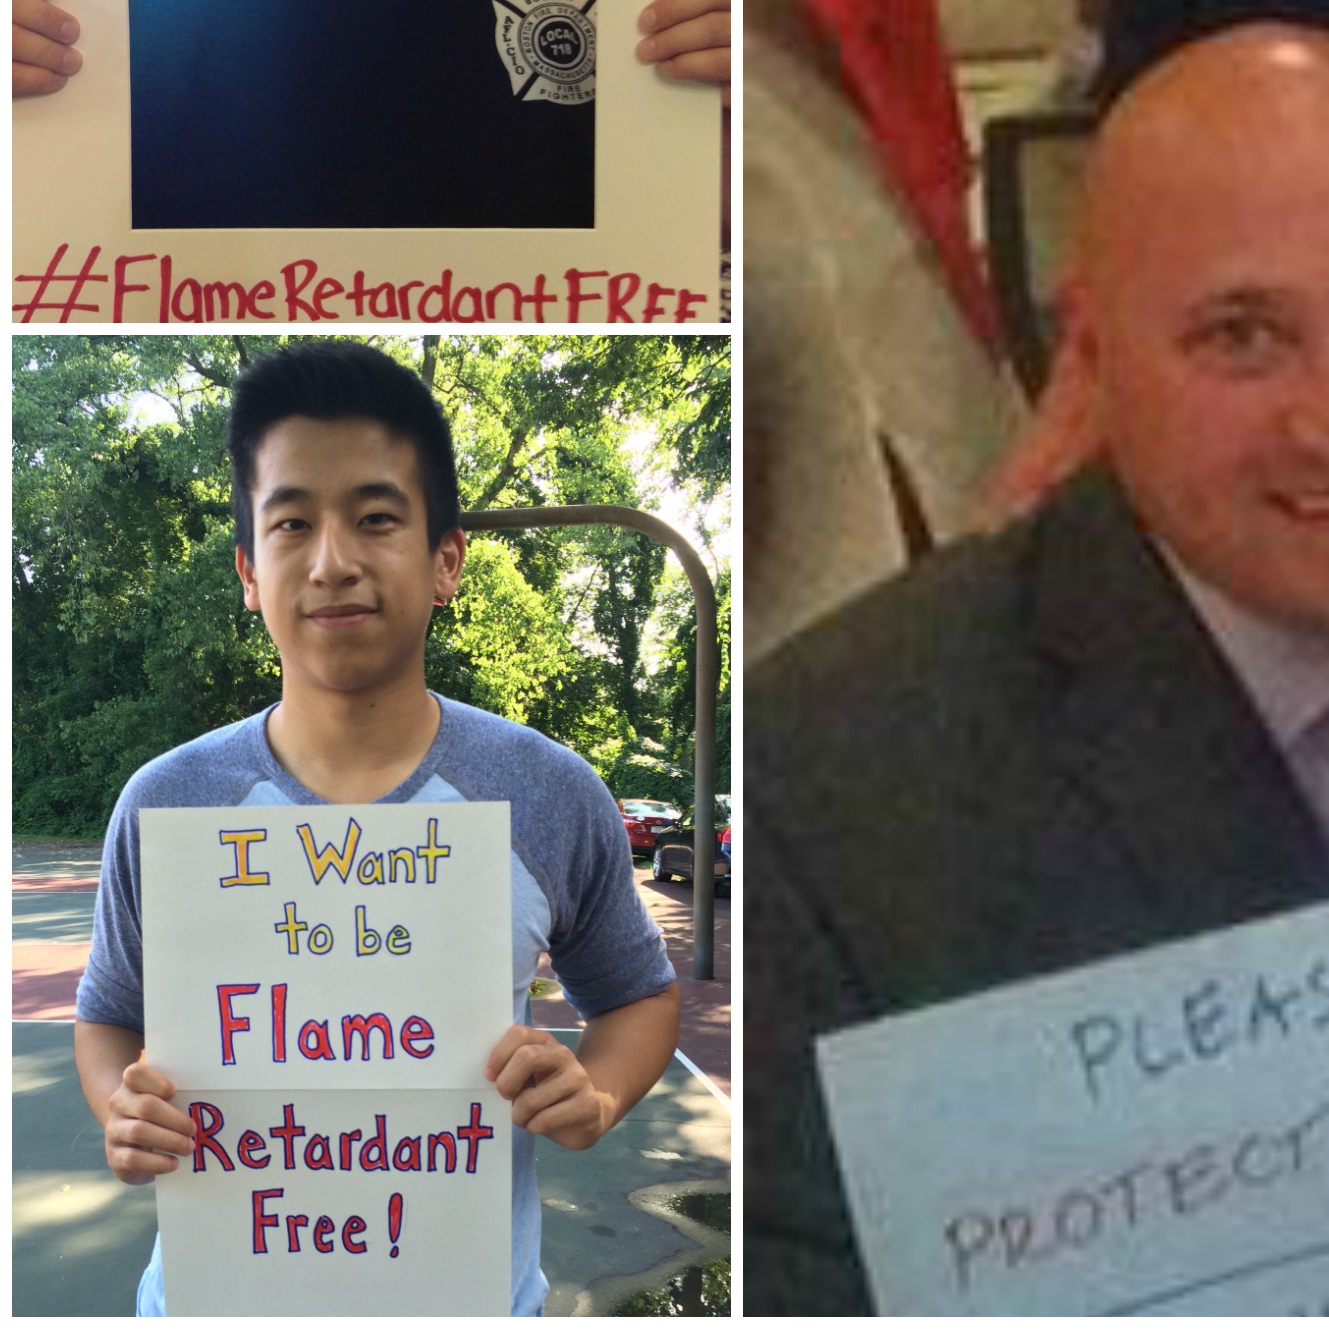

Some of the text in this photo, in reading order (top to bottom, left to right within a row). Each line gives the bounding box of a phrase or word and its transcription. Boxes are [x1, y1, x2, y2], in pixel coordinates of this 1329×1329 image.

[533, 7, 552, 20] FIRE
[540, 28, 579, 46] LOCAL
[550, 43, 572, 56] 718
[556, 85, 581, 93] FIRE
[219, 817, 451, 888] I Want
[275, 902, 412, 957] to be
[216, 982, 435, 1066] Flame
[188, 1101, 494, 1174] Retardant
